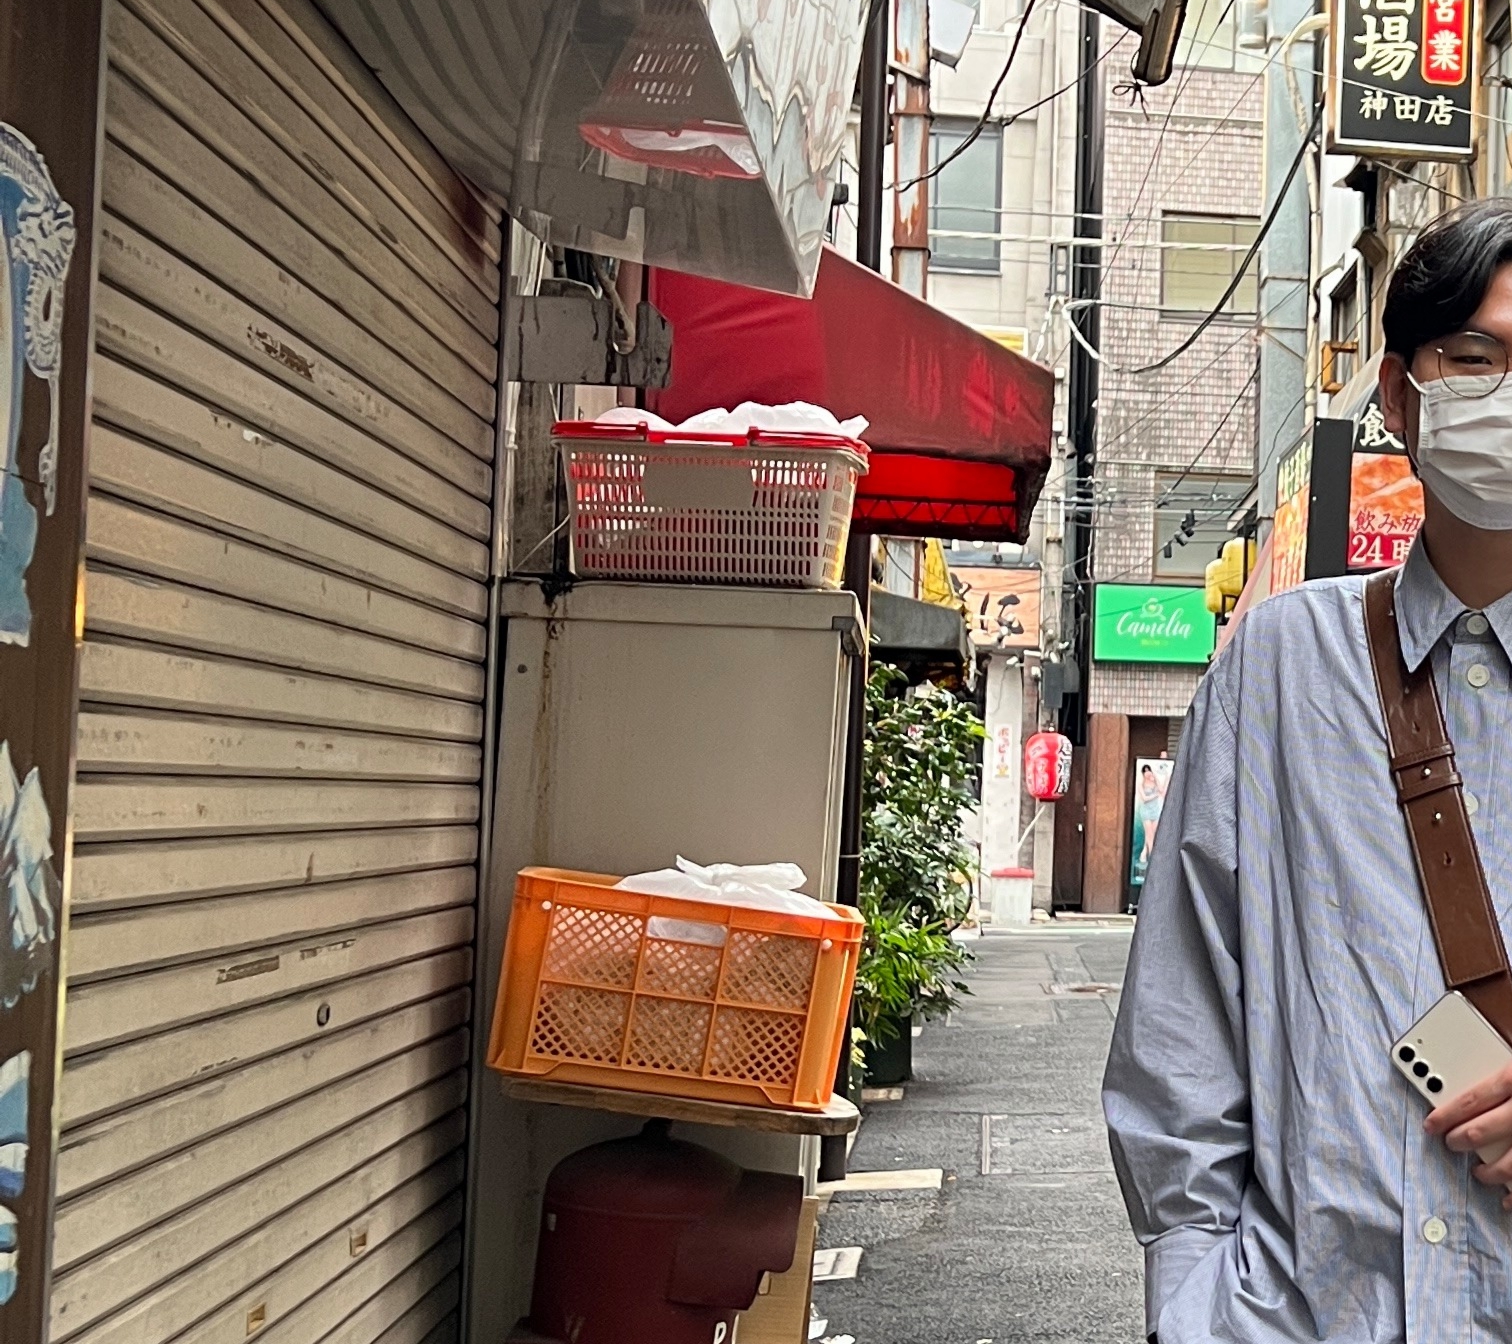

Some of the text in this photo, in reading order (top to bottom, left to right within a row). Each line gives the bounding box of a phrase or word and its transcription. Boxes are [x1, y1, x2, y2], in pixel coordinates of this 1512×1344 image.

[1358, 89, 1454, 126] 神田店
[1116, 607, 1193, 639] Camelia
